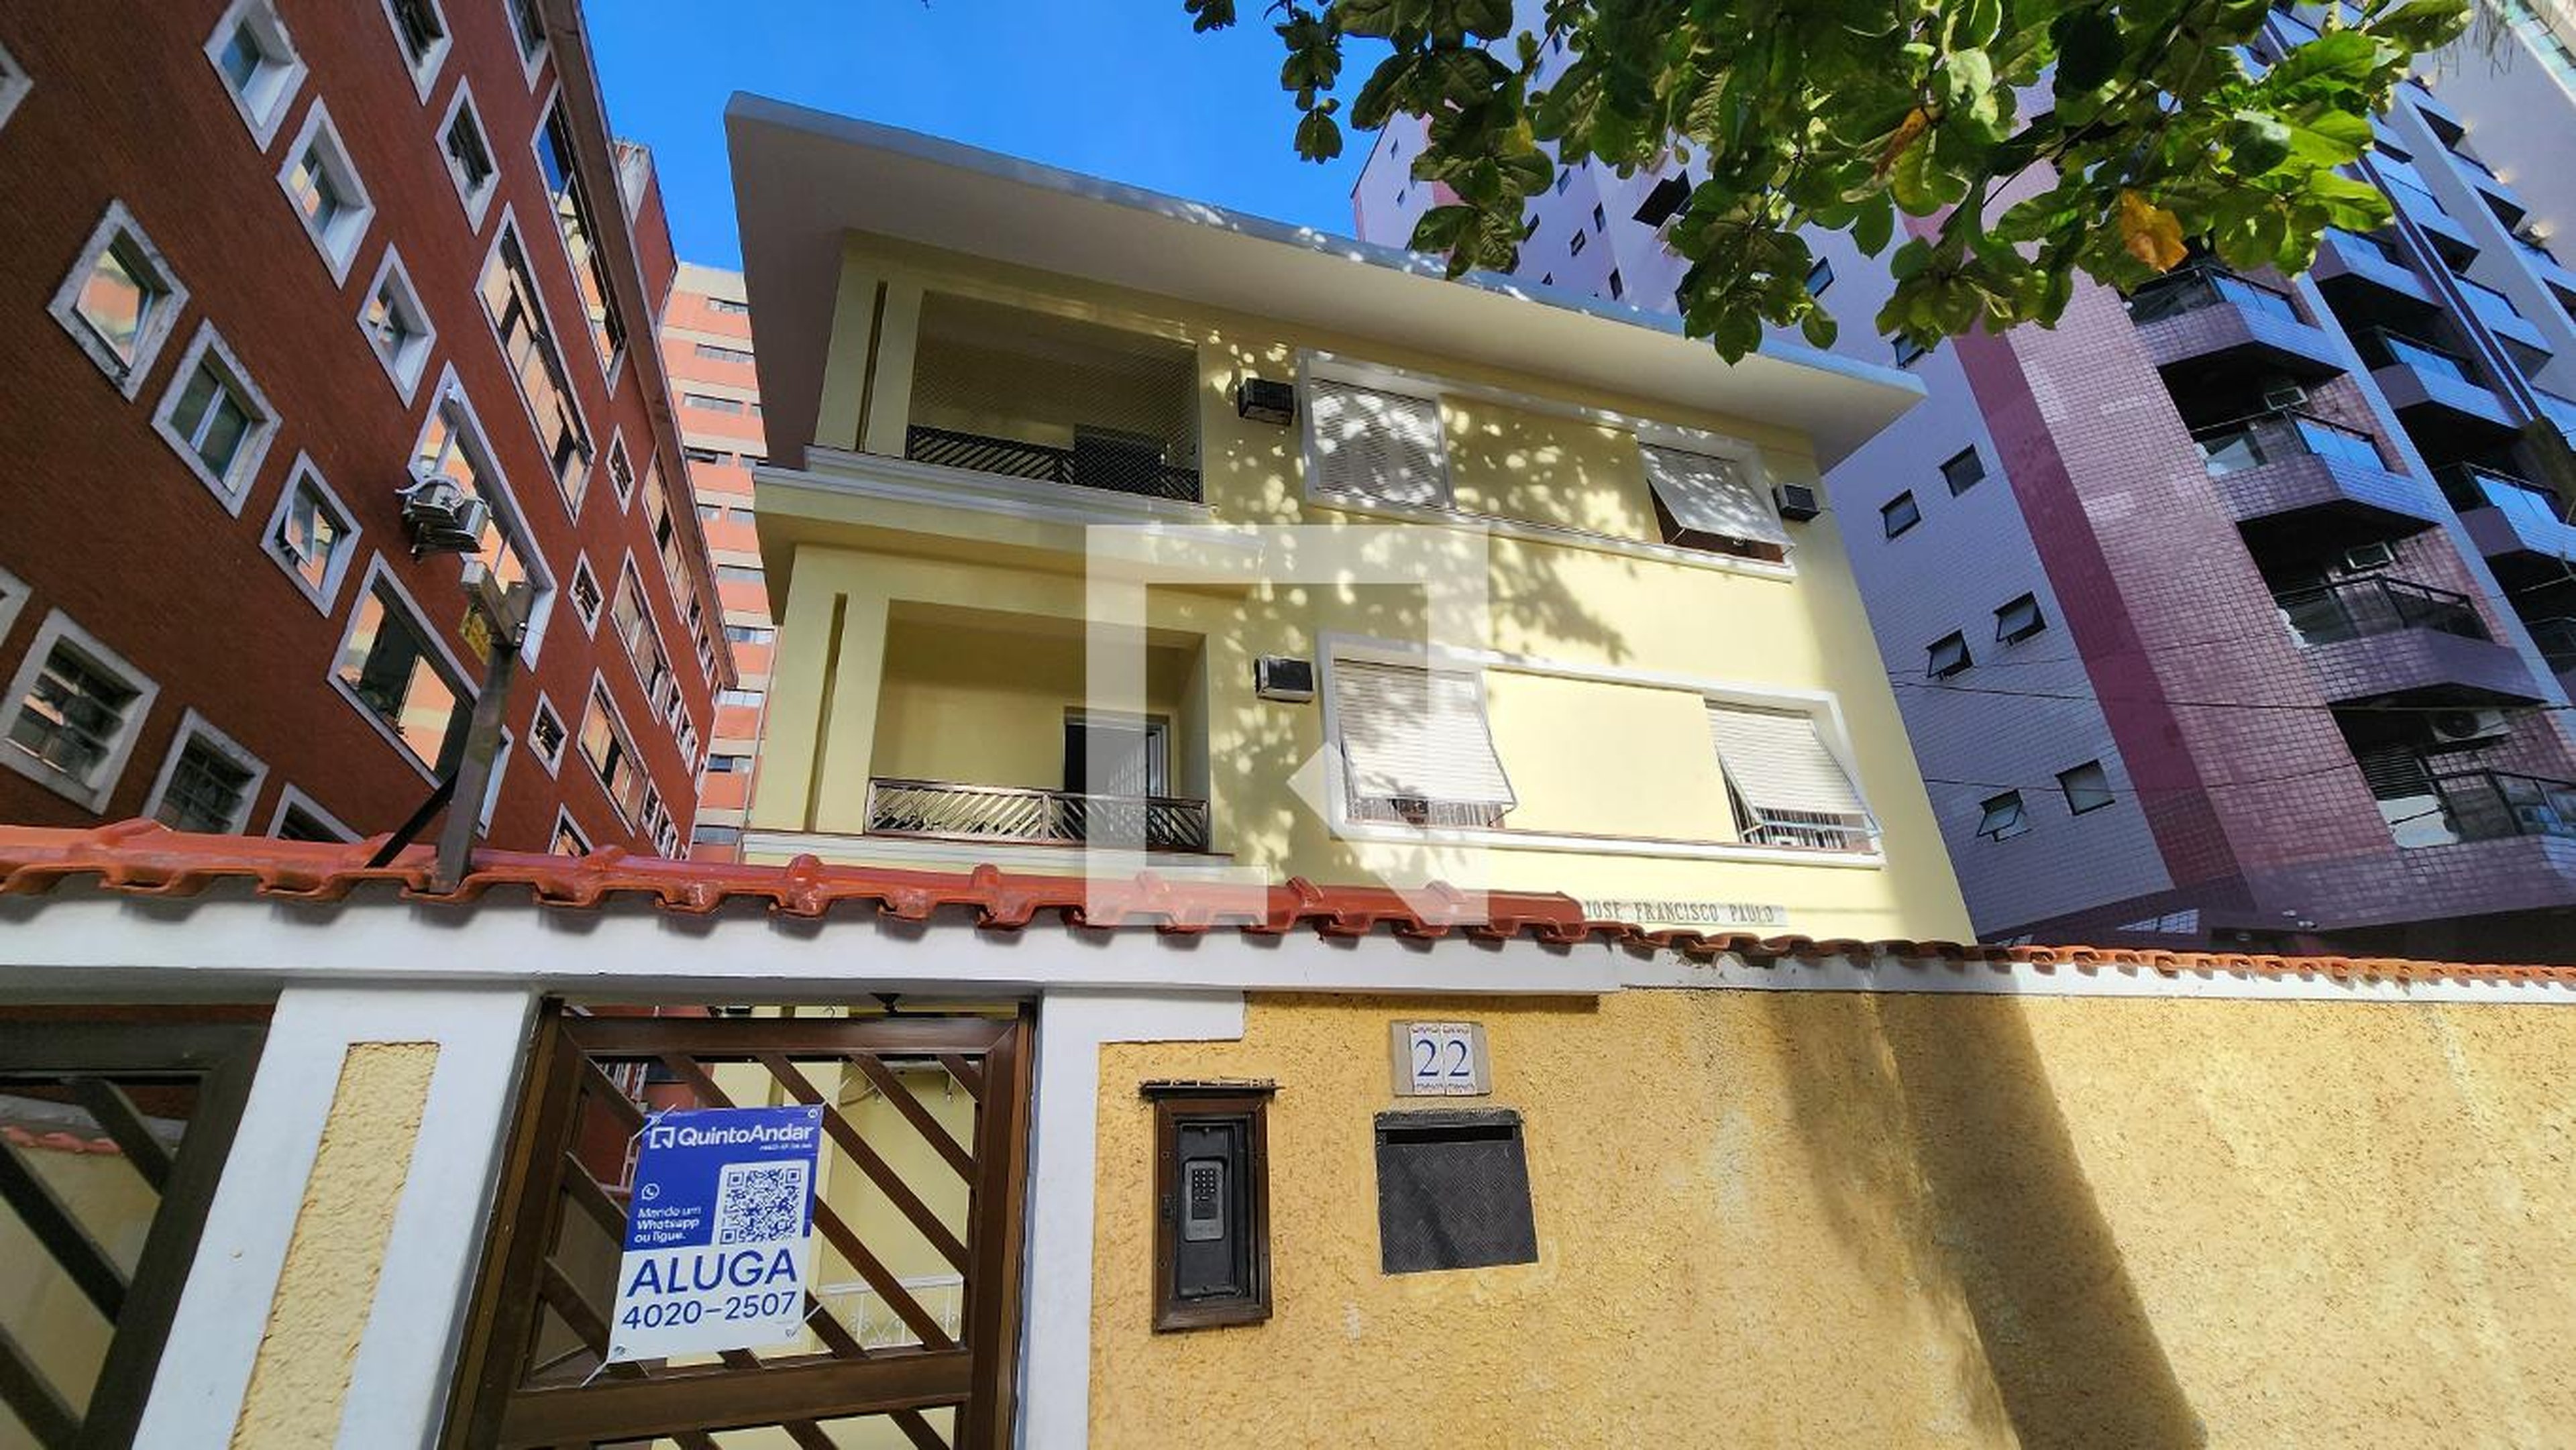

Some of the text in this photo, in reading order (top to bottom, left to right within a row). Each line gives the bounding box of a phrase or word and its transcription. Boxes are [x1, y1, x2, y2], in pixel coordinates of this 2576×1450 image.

[1633, 901, 1719, 922] FRANCISCO
[1729, 903, 1774, 922] PAULO
[1415, 1039, 1470, 1078] 22
[678, 1123, 814, 1147] QuintoAndar
[682, 1207, 702, 1215] um
[634, 1234, 651, 1243] ou
[626, 1248, 798, 1298] ALUGA
[622, 1290, 797, 1331] 4020-2507
